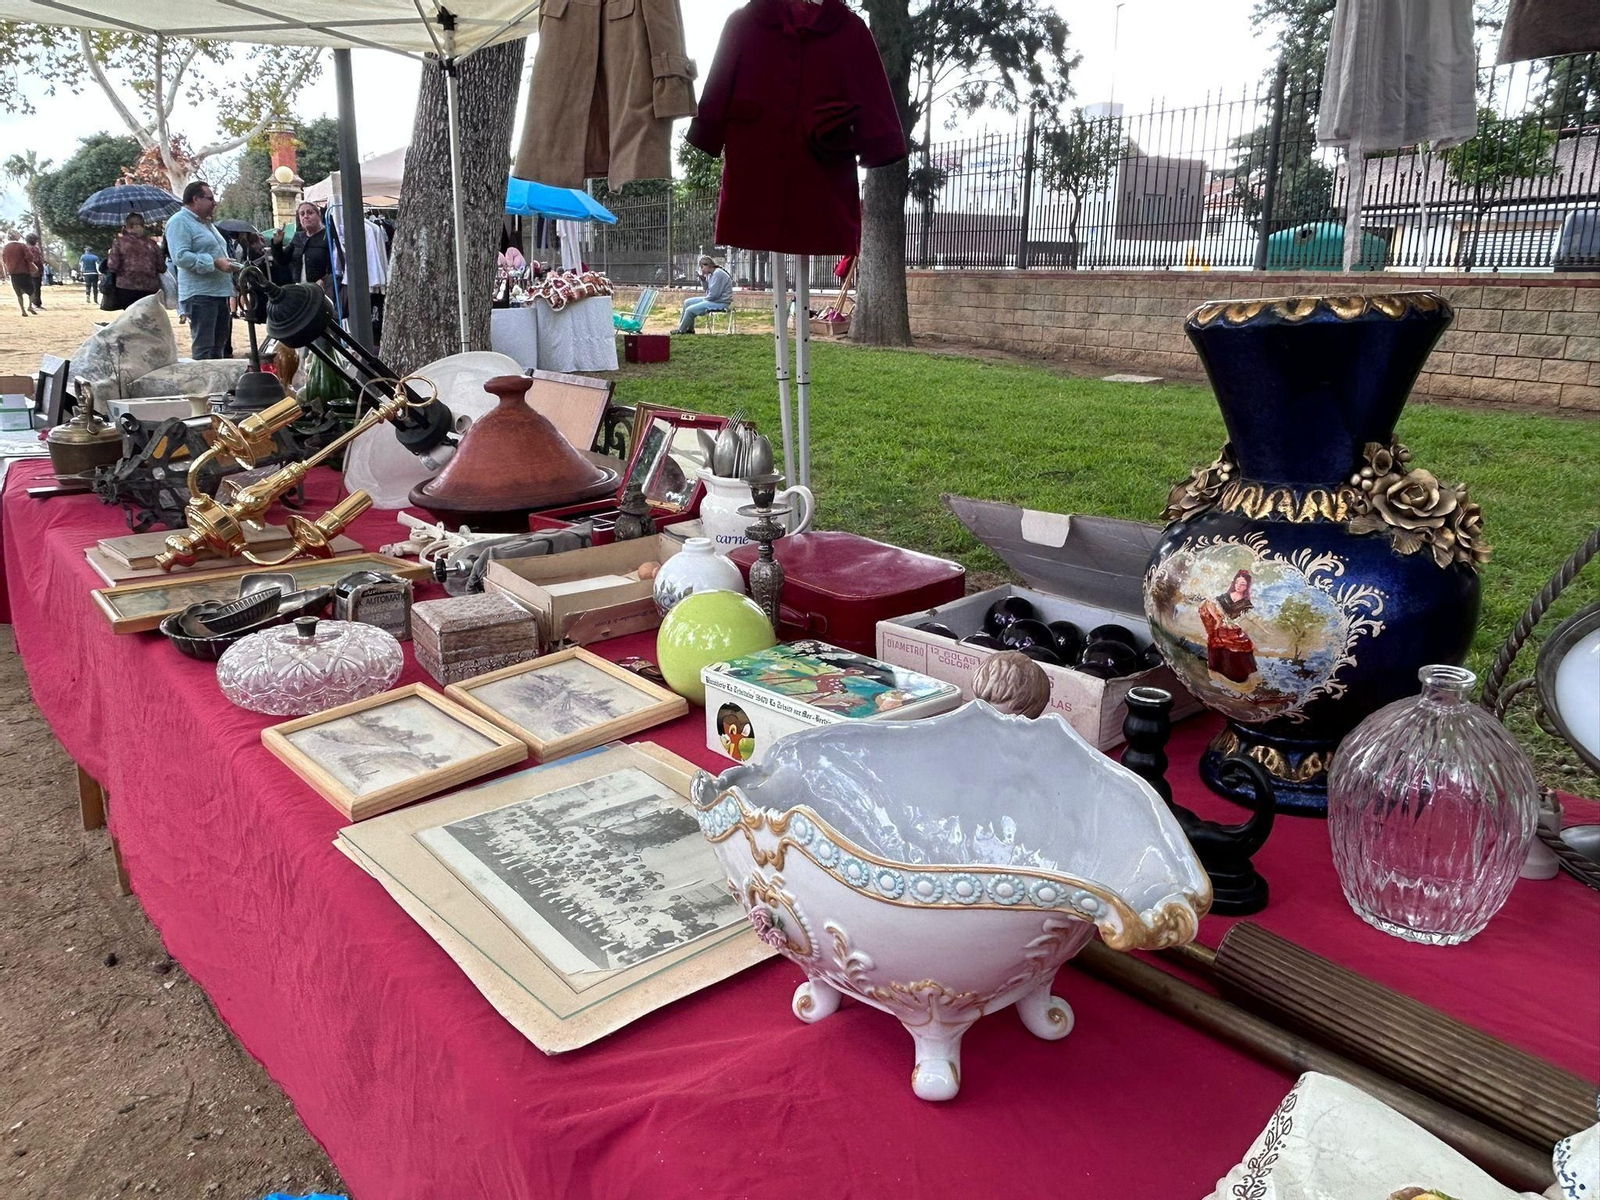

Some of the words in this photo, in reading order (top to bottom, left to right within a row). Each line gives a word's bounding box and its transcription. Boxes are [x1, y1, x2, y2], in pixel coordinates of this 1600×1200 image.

[715, 534, 749, 545] carne
[887, 638, 924, 657] DIAMETRO
[930, 646, 940, 655] 12
[1050, 697, 1073, 713] LAS
